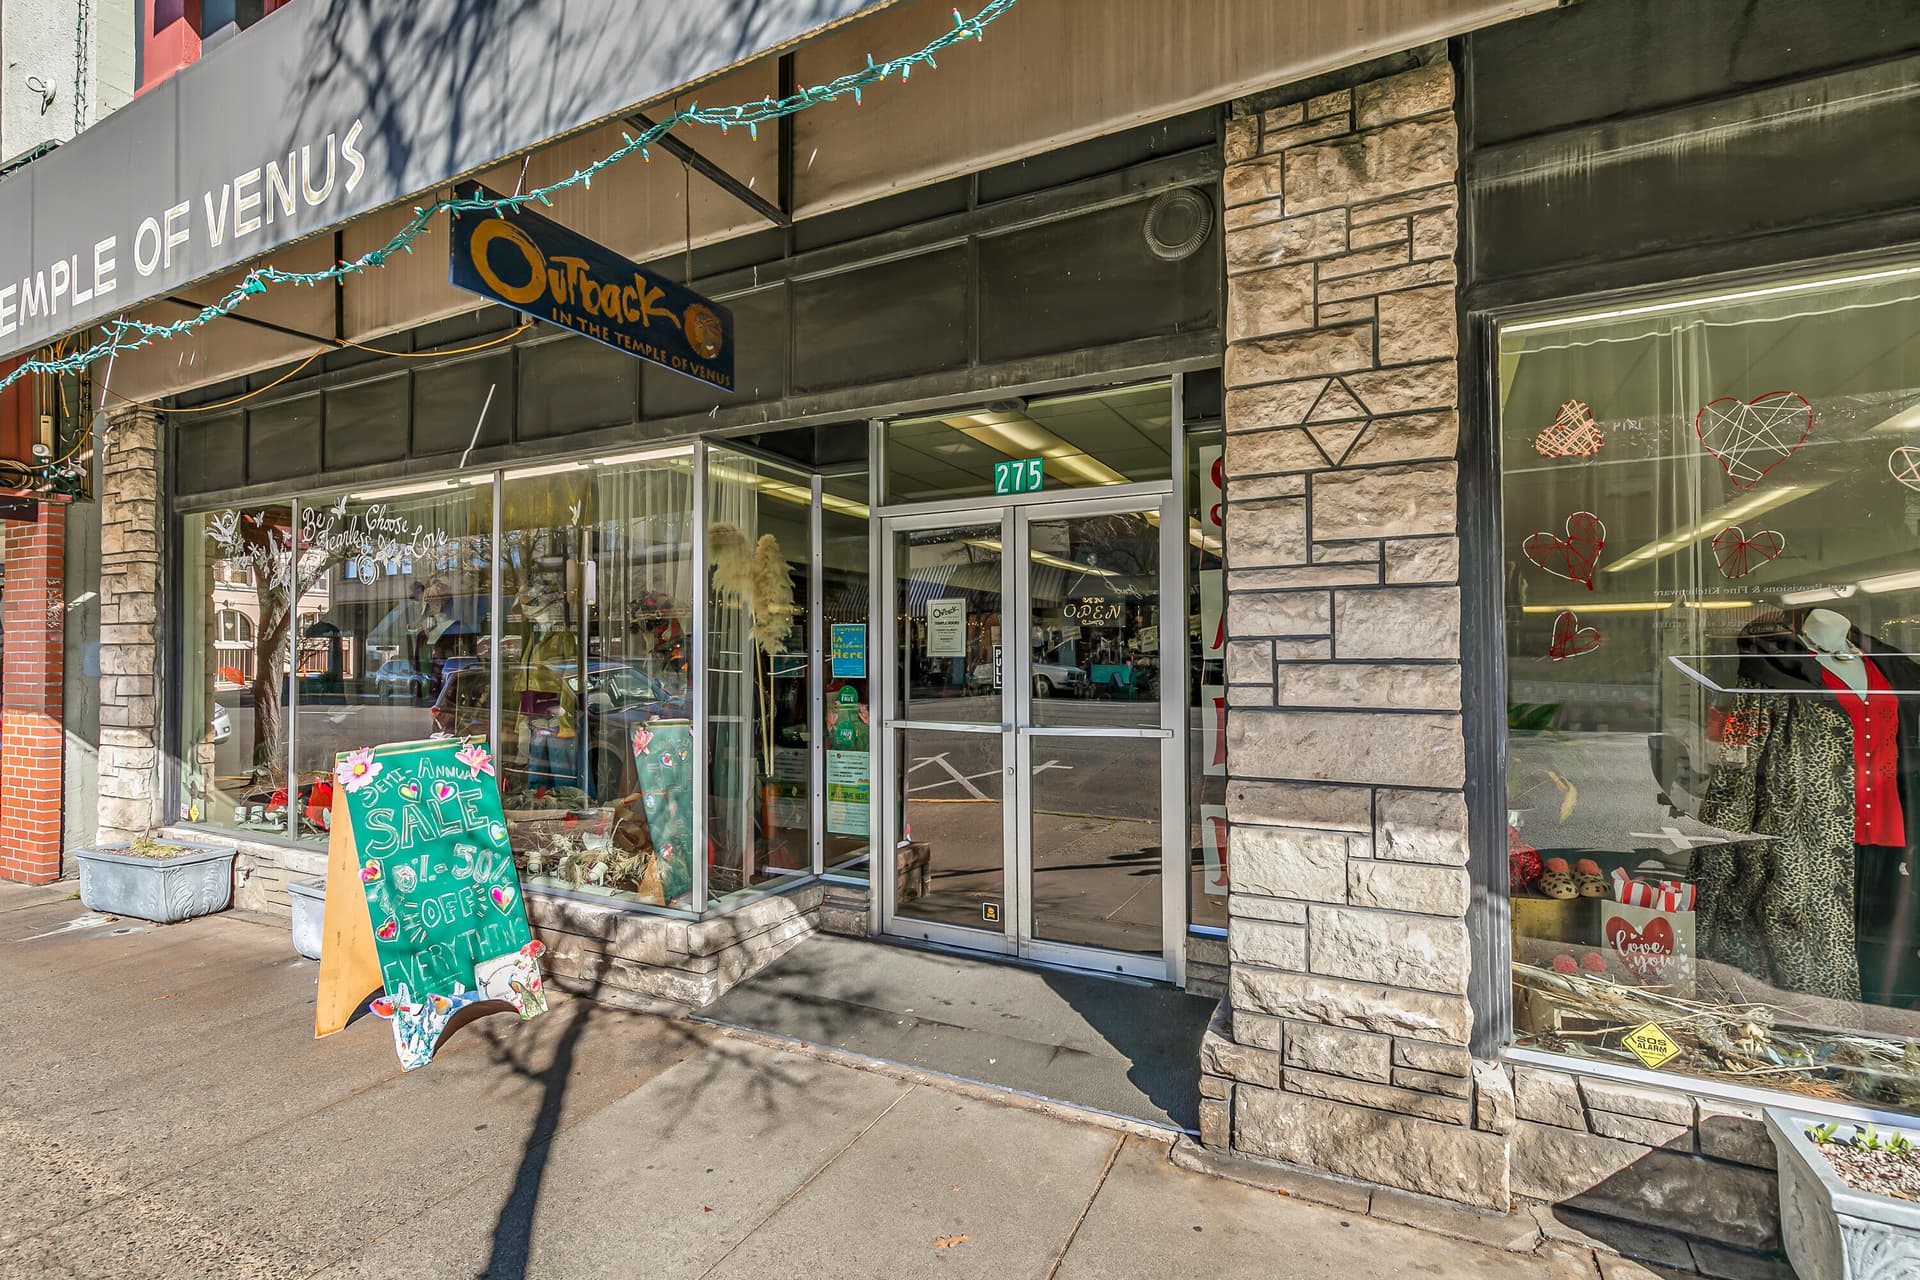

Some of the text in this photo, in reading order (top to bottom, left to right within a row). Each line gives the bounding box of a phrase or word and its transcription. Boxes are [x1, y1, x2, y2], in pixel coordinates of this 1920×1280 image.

[133, 200, 191, 277] OF
[204, 118, 366, 248] VENUS
[552, 308, 731, 387] IN THE TEMPLE OF VENUS
[997, 460, 1041, 493] 275
[302, 507, 325, 542] Be
[366, 504, 408, 535] Choose
[405, 524, 449, 559] Love
[1063, 603, 1121, 619] OPEN
[365, 788, 490, 860] SALE
[421, 886, 474, 928] OFF
[1616, 929, 1664, 957] love
[1633, 955, 1676, 975] you
[1636, 1035, 1667, 1046] SOS
[1636, 1042, 1667, 1054] ALARM
